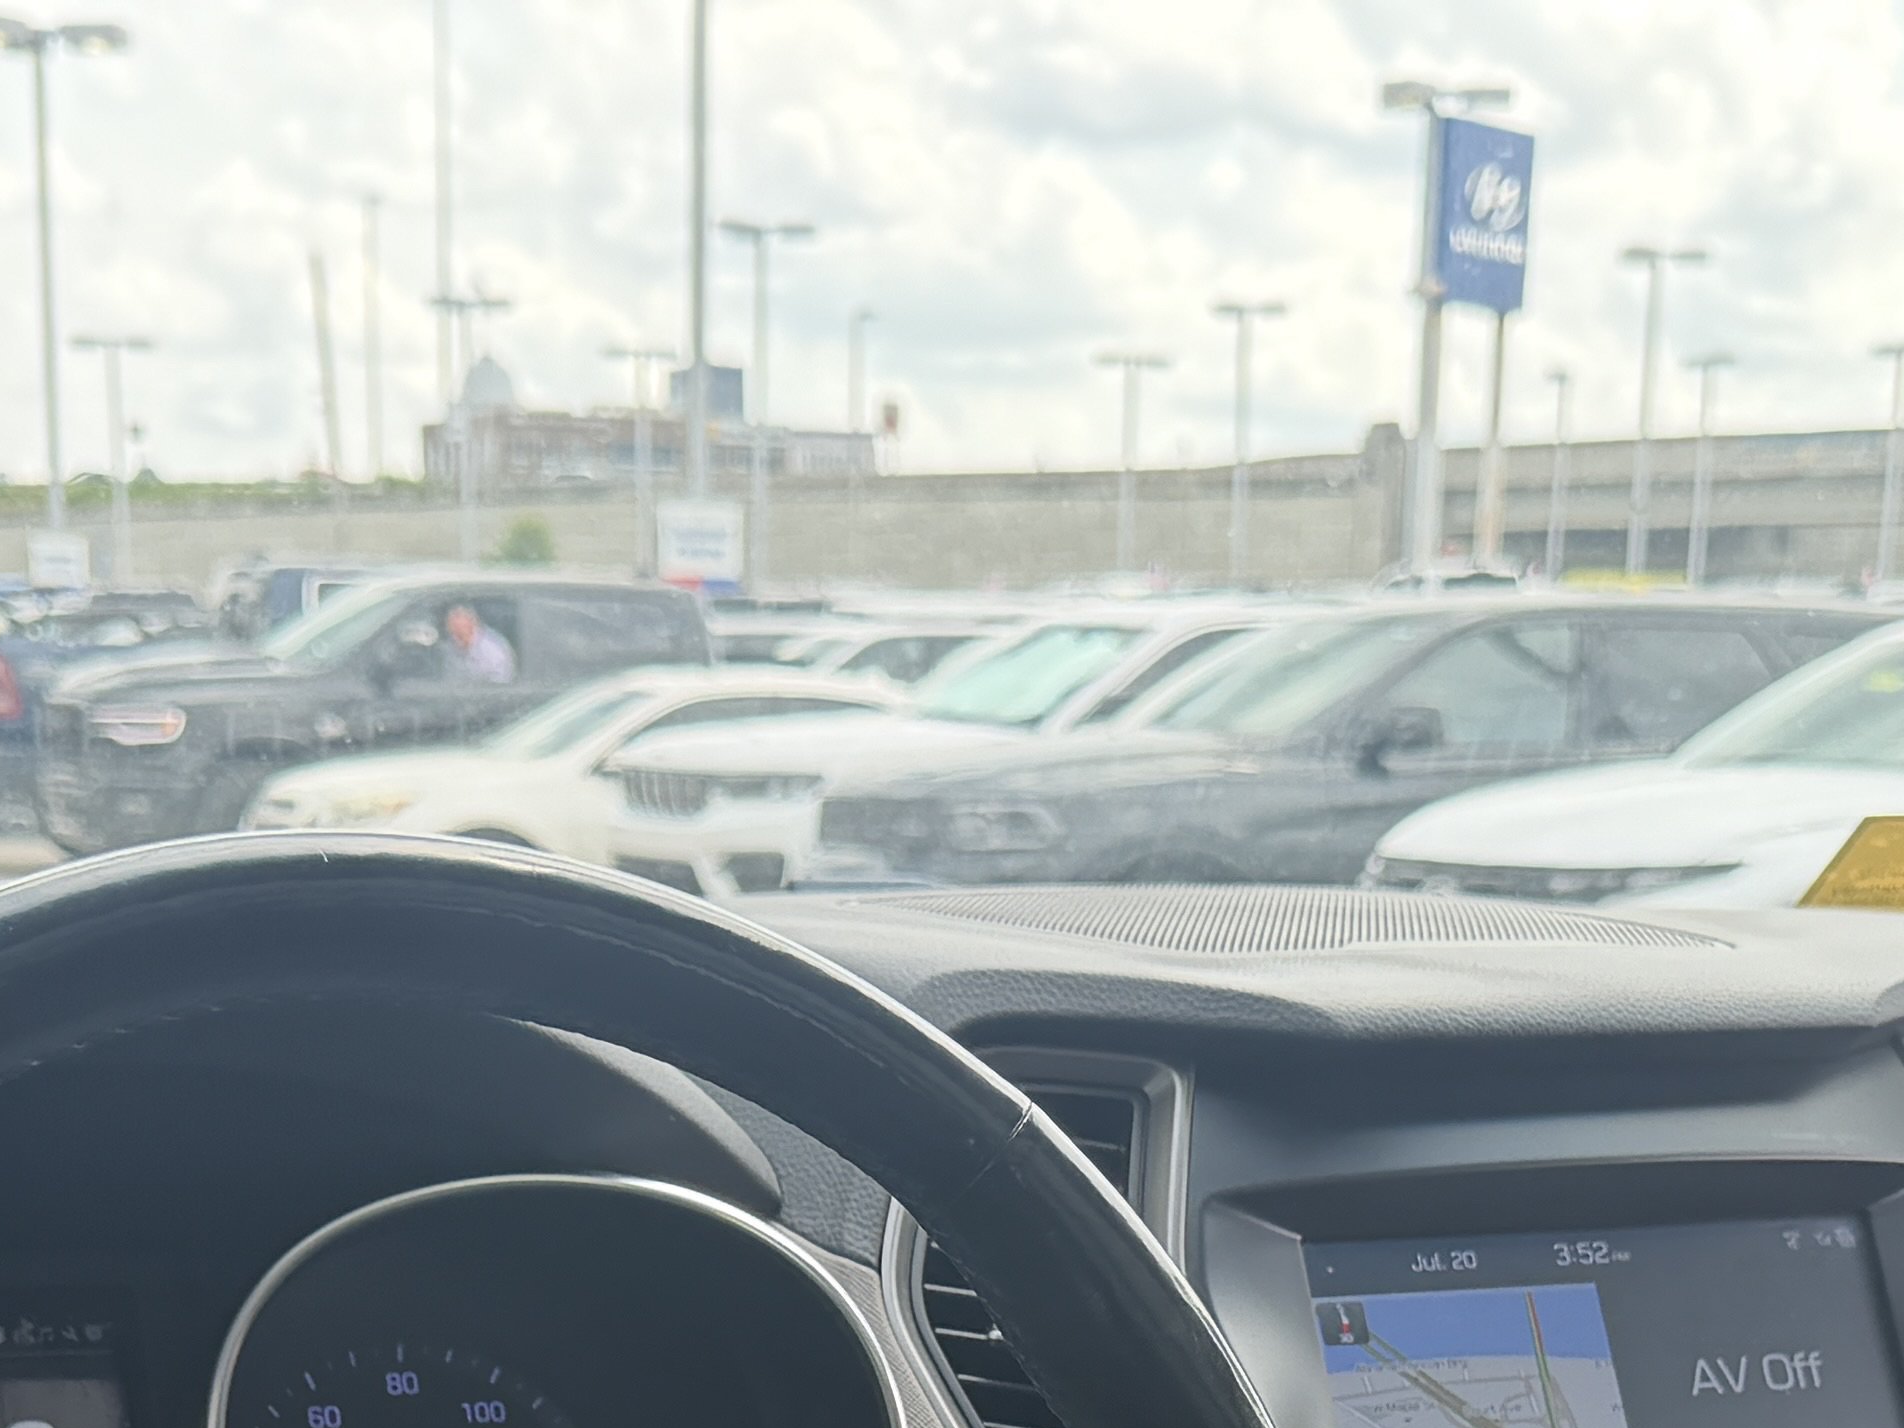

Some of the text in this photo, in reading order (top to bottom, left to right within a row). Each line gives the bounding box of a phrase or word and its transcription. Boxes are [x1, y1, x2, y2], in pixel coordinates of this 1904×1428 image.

[1451, 1250, 1478, 1270] 20
[1553, 1240, 1610, 1266] 3:52
[384, 1371, 420, 1397] 80
[1691, 1349, 1823, 1399] AV Off
[461, 1401, 507, 1424] 100
